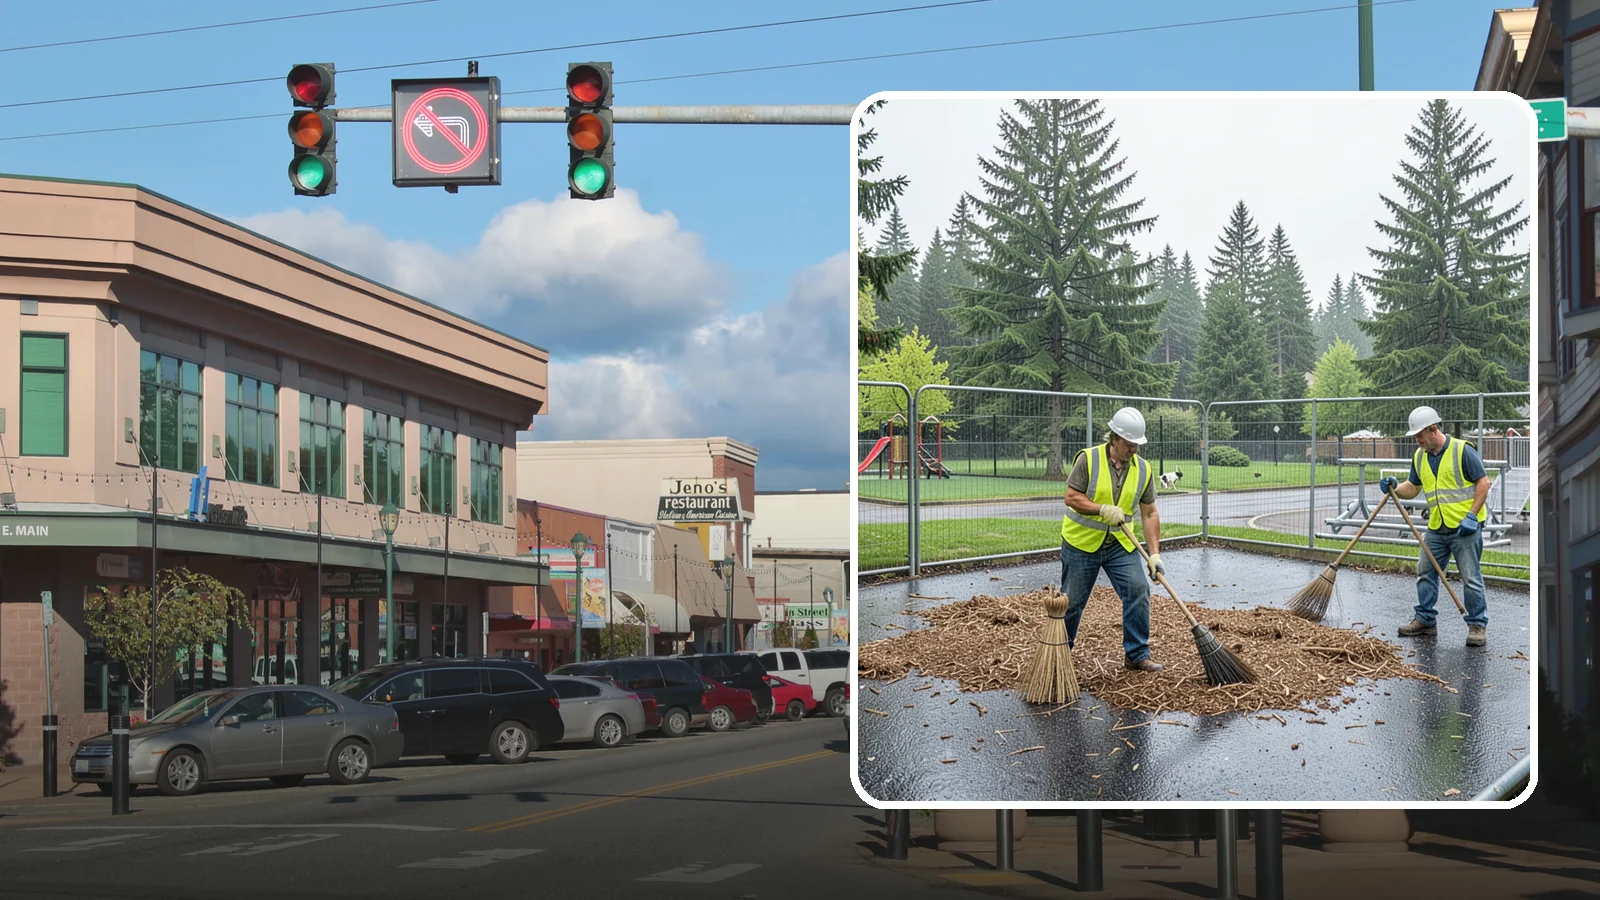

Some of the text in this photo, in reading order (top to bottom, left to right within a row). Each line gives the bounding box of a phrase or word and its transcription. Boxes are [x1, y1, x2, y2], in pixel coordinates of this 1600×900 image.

[670, 480, 727, 494] Jeno's
[665, 496, 731, 509] restaurant
[658, 510, 681, 519] Italian
[686, 510, 714, 519] American
[714, 509, 737, 519] Cuisine
[2, 525, 49, 536] E. MAIN
[797, 608, 828, 616] Street
[791, 619, 824, 627] lass
